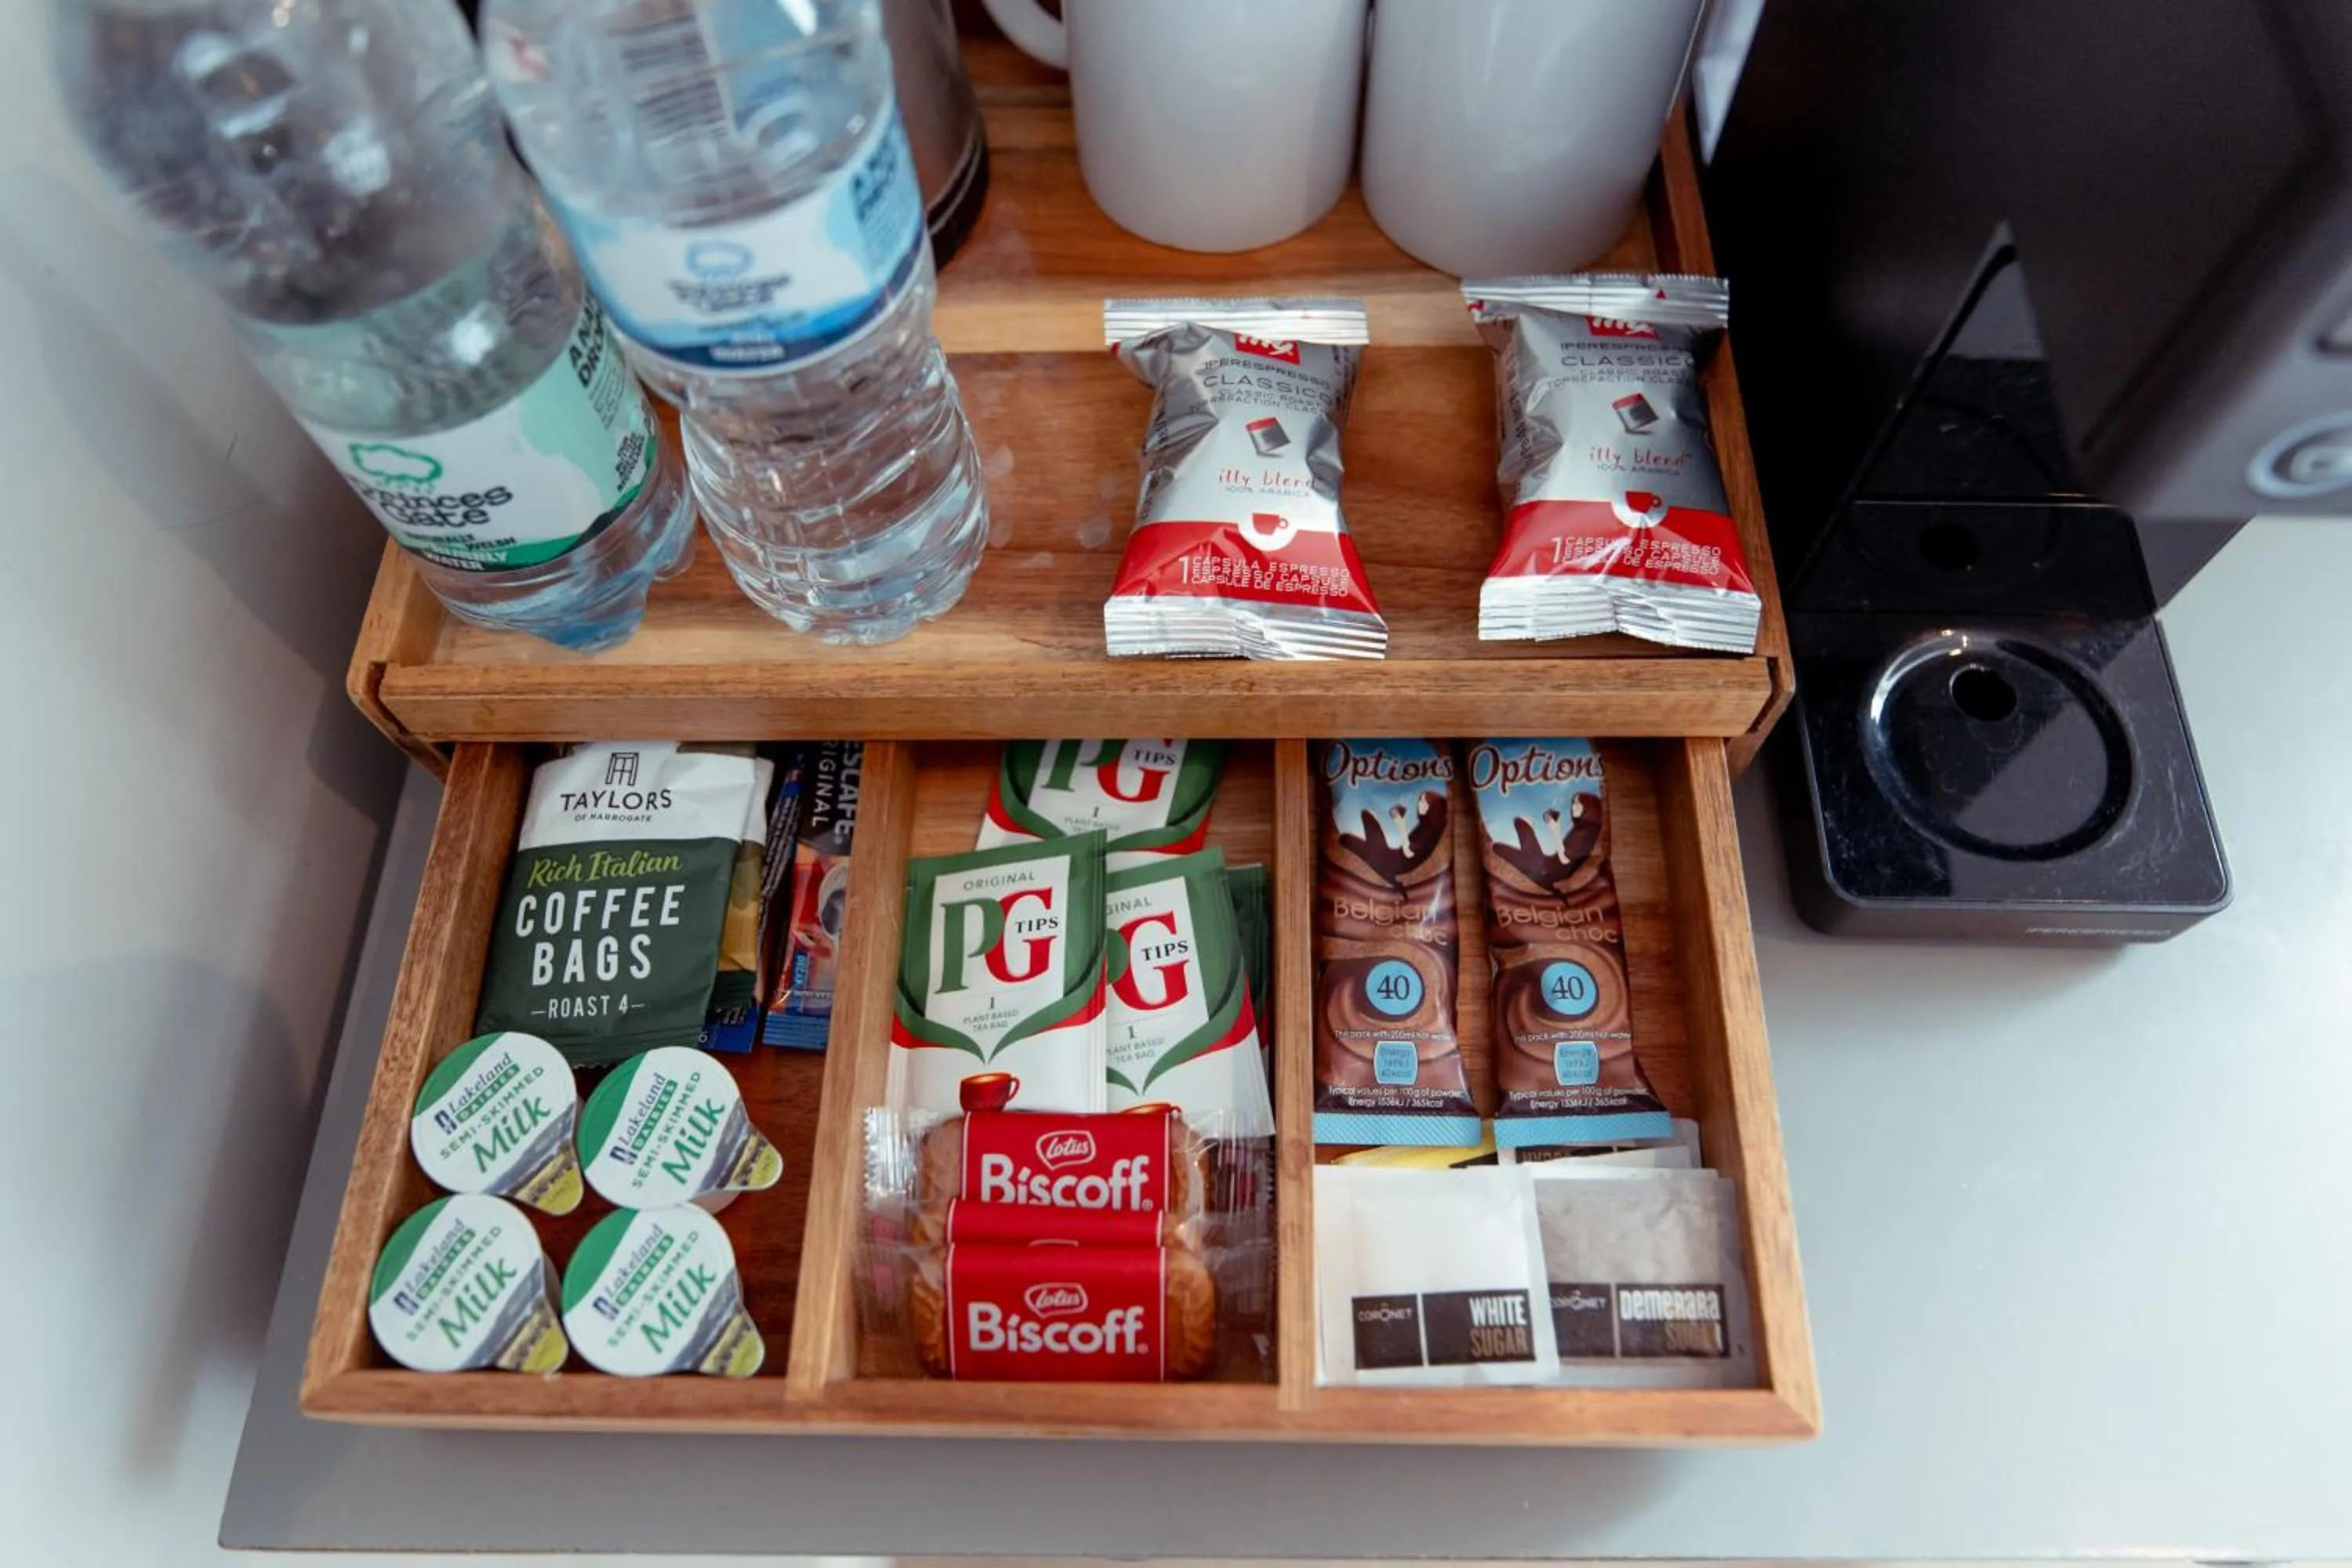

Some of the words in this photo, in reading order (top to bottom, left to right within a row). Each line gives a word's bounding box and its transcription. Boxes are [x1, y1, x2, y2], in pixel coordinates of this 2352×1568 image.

[1203, 375, 1333, 405] CLASSICO
[1589, 447, 1621, 464] illy
[1218, 469, 1250, 487] illy
[1552, 536, 1563, 564] 1
[1178, 556, 1190, 584] 1
[1192, 556, 1261, 571] CAPSULA
[1269, 561, 1350, 579] ESPRESSO
[1192, 564, 1275, 581] ESPRESSO
[1280, 573, 1350, 588] CAPSULE
[1192, 575, 1250, 588] CAPSULE
[1254, 579, 1271, 590] DE
[1276, 583, 1348, 597] ESPRESSO
[1134, 750, 1178, 766] TIPS
[1320, 740, 1454, 788] Options
[1468, 744, 1606, 795] Options
[560, 789, 673, 811] TAYLORS
[575, 814, 586, 822] OF
[590, 813, 652, 822] HARROGATE
[527, 854, 582, 888] Rich
[584, 850, 684, 882] Italian
[963, 871, 1035, 891] ORIGINAL
[515, 884, 686, 938] COFFEE
[1105, 896, 1152, 916] GINAL
[1496, 904, 1605, 928] Belgian
[934, 887, 1058, 995] PG
[1014, 916, 1059, 934] TIPS
[1555, 925, 1619, 943] choc
[532, 933, 652, 986] BAGS
[1142, 940, 1189, 961] TIPS
[1376, 974, 1411, 1001] 40
[1552, 975, 1584, 1000] 40
[548, 995, 610, 1019] ROAST
[618, 993, 629, 1014] 4
[449, 1053, 513, 1114] Lakeland
[440, 1065, 545, 1161] SEMI-SKIMMED
[619, 1072, 666, 1146] Lakeland
[473, 1096, 552, 1174] Milk
[632, 1070, 701, 1189] SEMI-SKIMMED
[660, 1098, 725, 1185] Milk
[1046, 1136, 1090, 1160] Lotus
[980, 1152, 1151, 1211] Biscoff
[437, 1257, 518, 1349] Milk
[640, 1263, 718, 1355] Milk
[1357, 1304, 1413, 1323] CORONET
[1468, 1295, 1528, 1327] WHITE
[967, 1301, 1145, 1356] Biscoff
[1468, 1327, 1529, 1358] SUGAR
